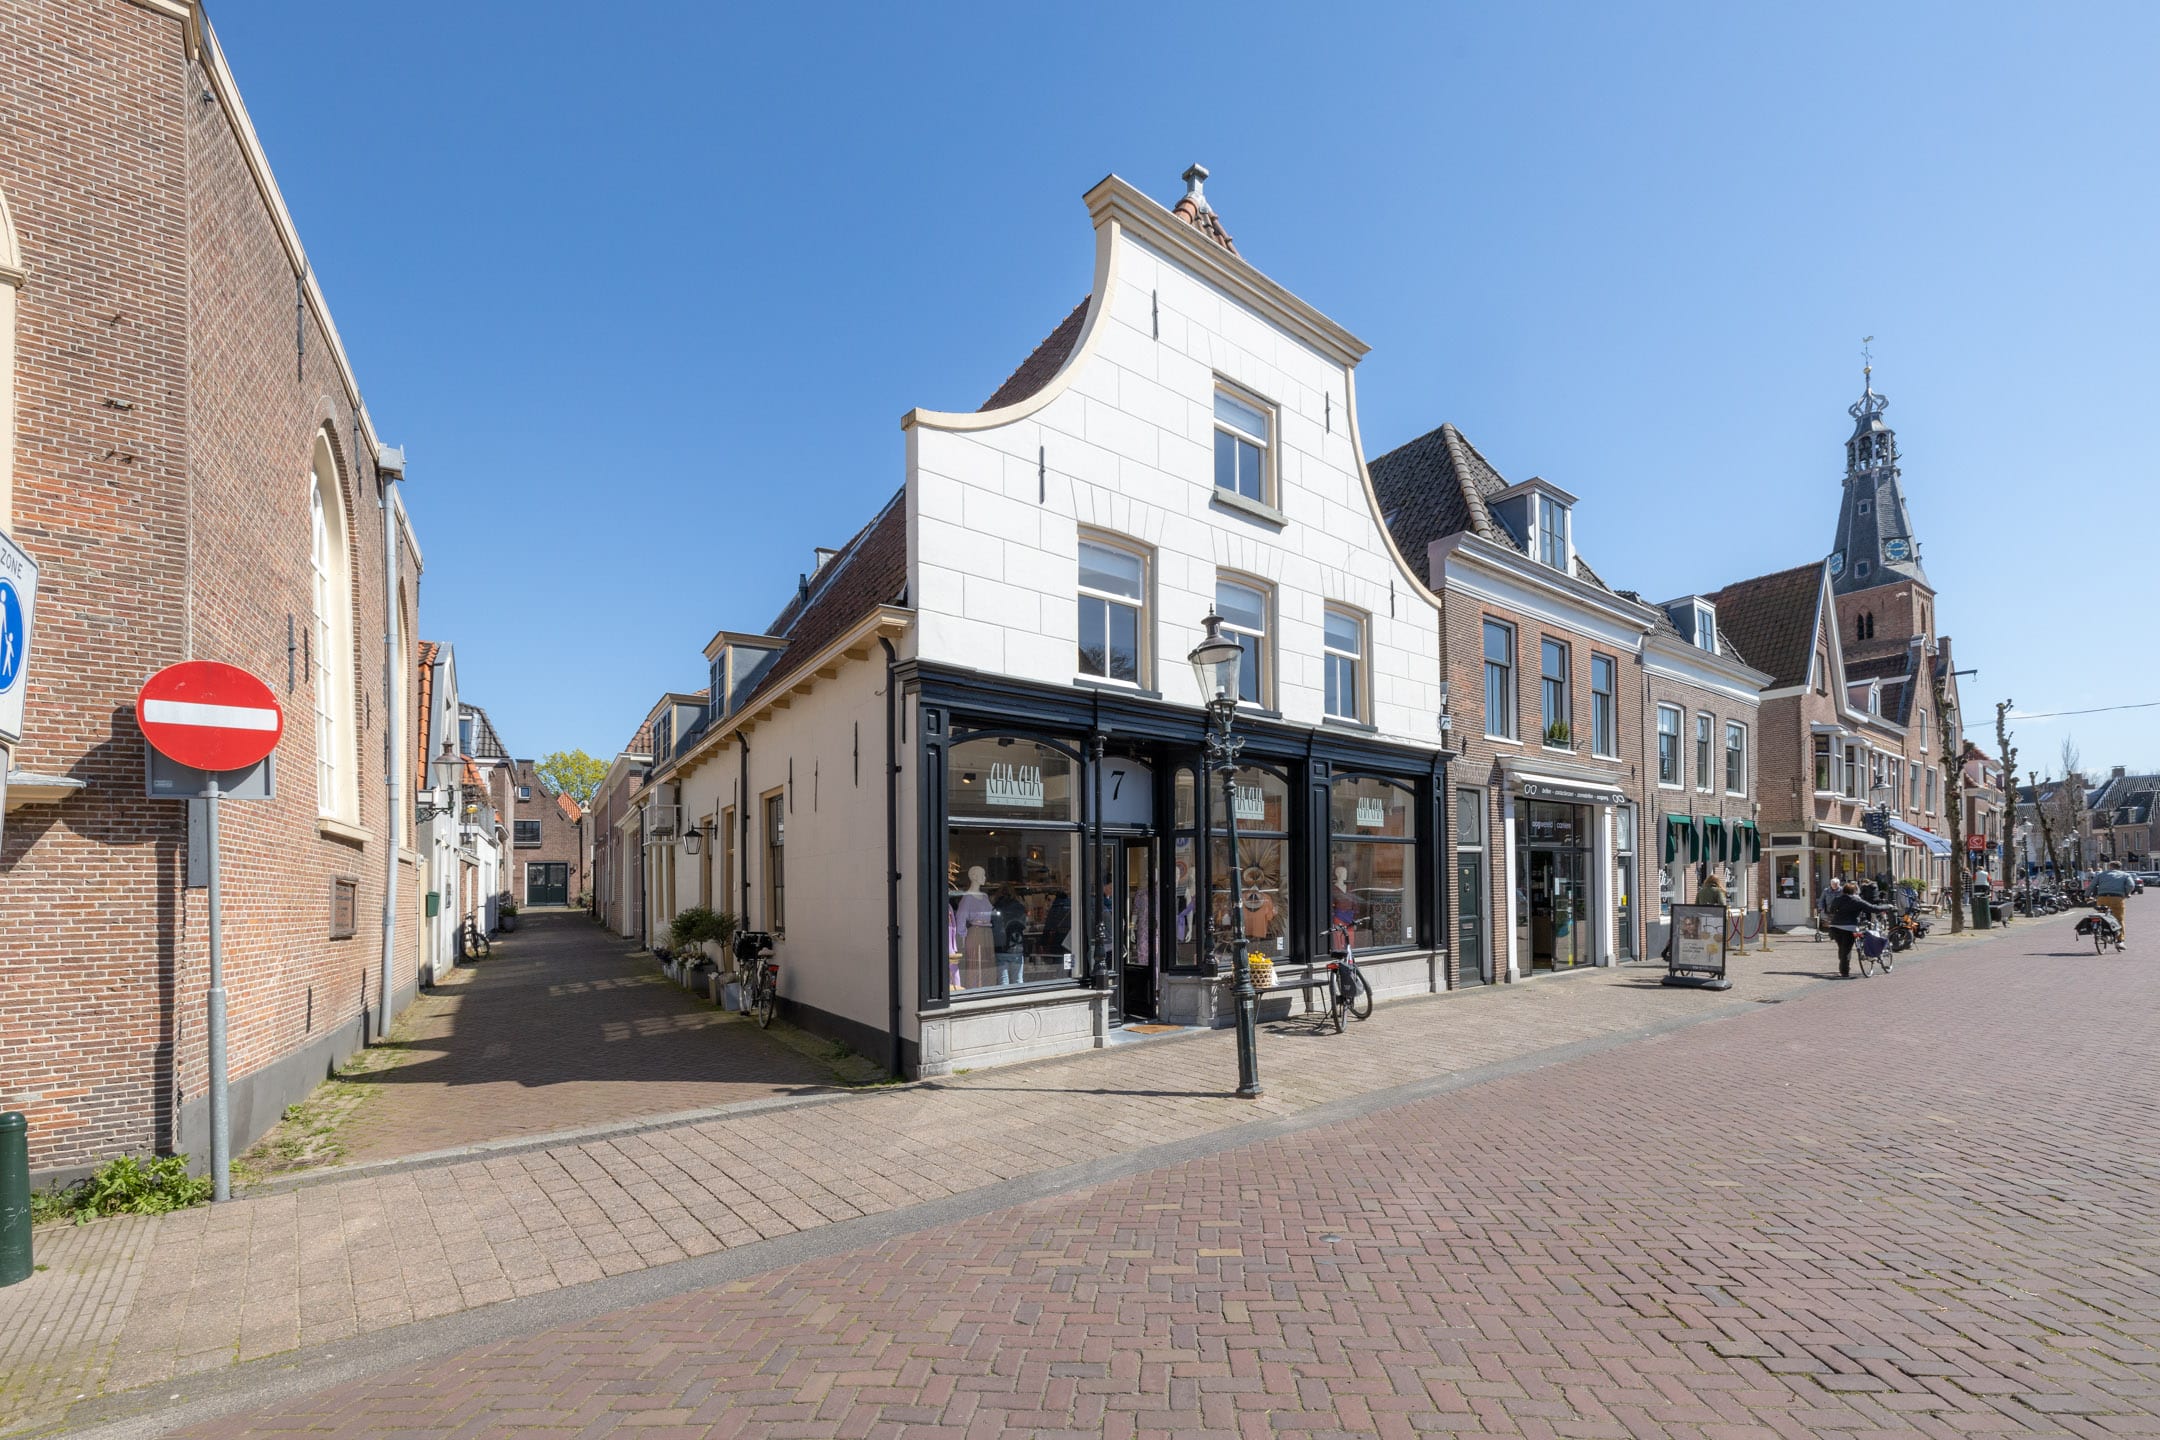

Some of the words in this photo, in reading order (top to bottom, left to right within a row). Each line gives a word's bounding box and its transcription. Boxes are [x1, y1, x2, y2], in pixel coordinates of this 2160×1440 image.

[1, 548, 23, 580] ZONE
[989, 762, 1014, 795] CHA
[1017, 765, 1041, 797] CHA
[1111, 770, 1126, 801] 7
[1248, 786, 1263, 813] CHA
[1358, 796, 1370, 819] CHA
